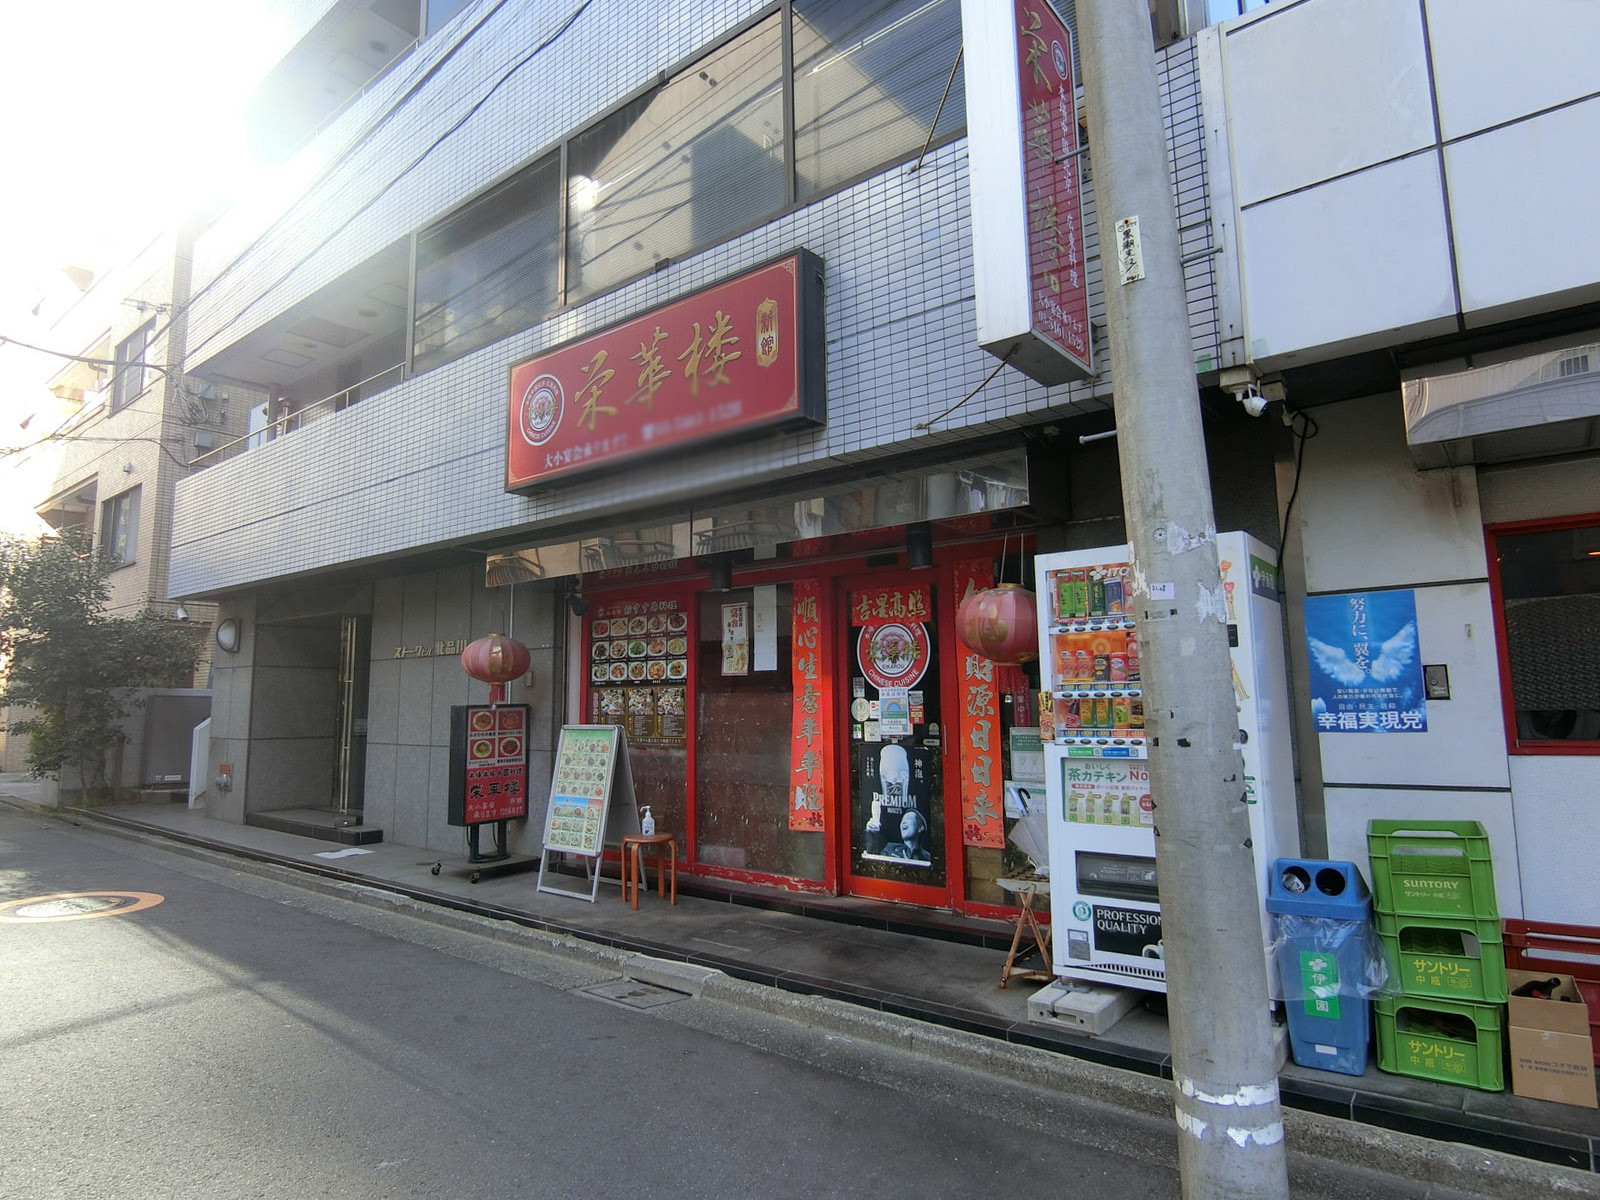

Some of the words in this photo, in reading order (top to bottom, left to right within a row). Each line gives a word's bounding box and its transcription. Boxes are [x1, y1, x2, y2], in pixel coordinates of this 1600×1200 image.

[760, 309, 774, 356] 新館
[854, 589, 927, 622] 吉星高照
[1350, 597, 1371, 674] 努力に、翼を。
[868, 669, 893, 688] CHINESE
[893, 668, 919, 688] CUISINE
[1317, 710, 1423, 730] 幸福実現党
[1067, 767, 1127, 782] 茶カテキン
[872, 791, 917, 809] PREMIUM
[1096, 919, 1147, 935] QUALITY
[1413, 959, 1471, 976] サントリー
[1311, 972, 1329, 1013] 伊園
[1408, 1039, 1465, 1059] サントリー
